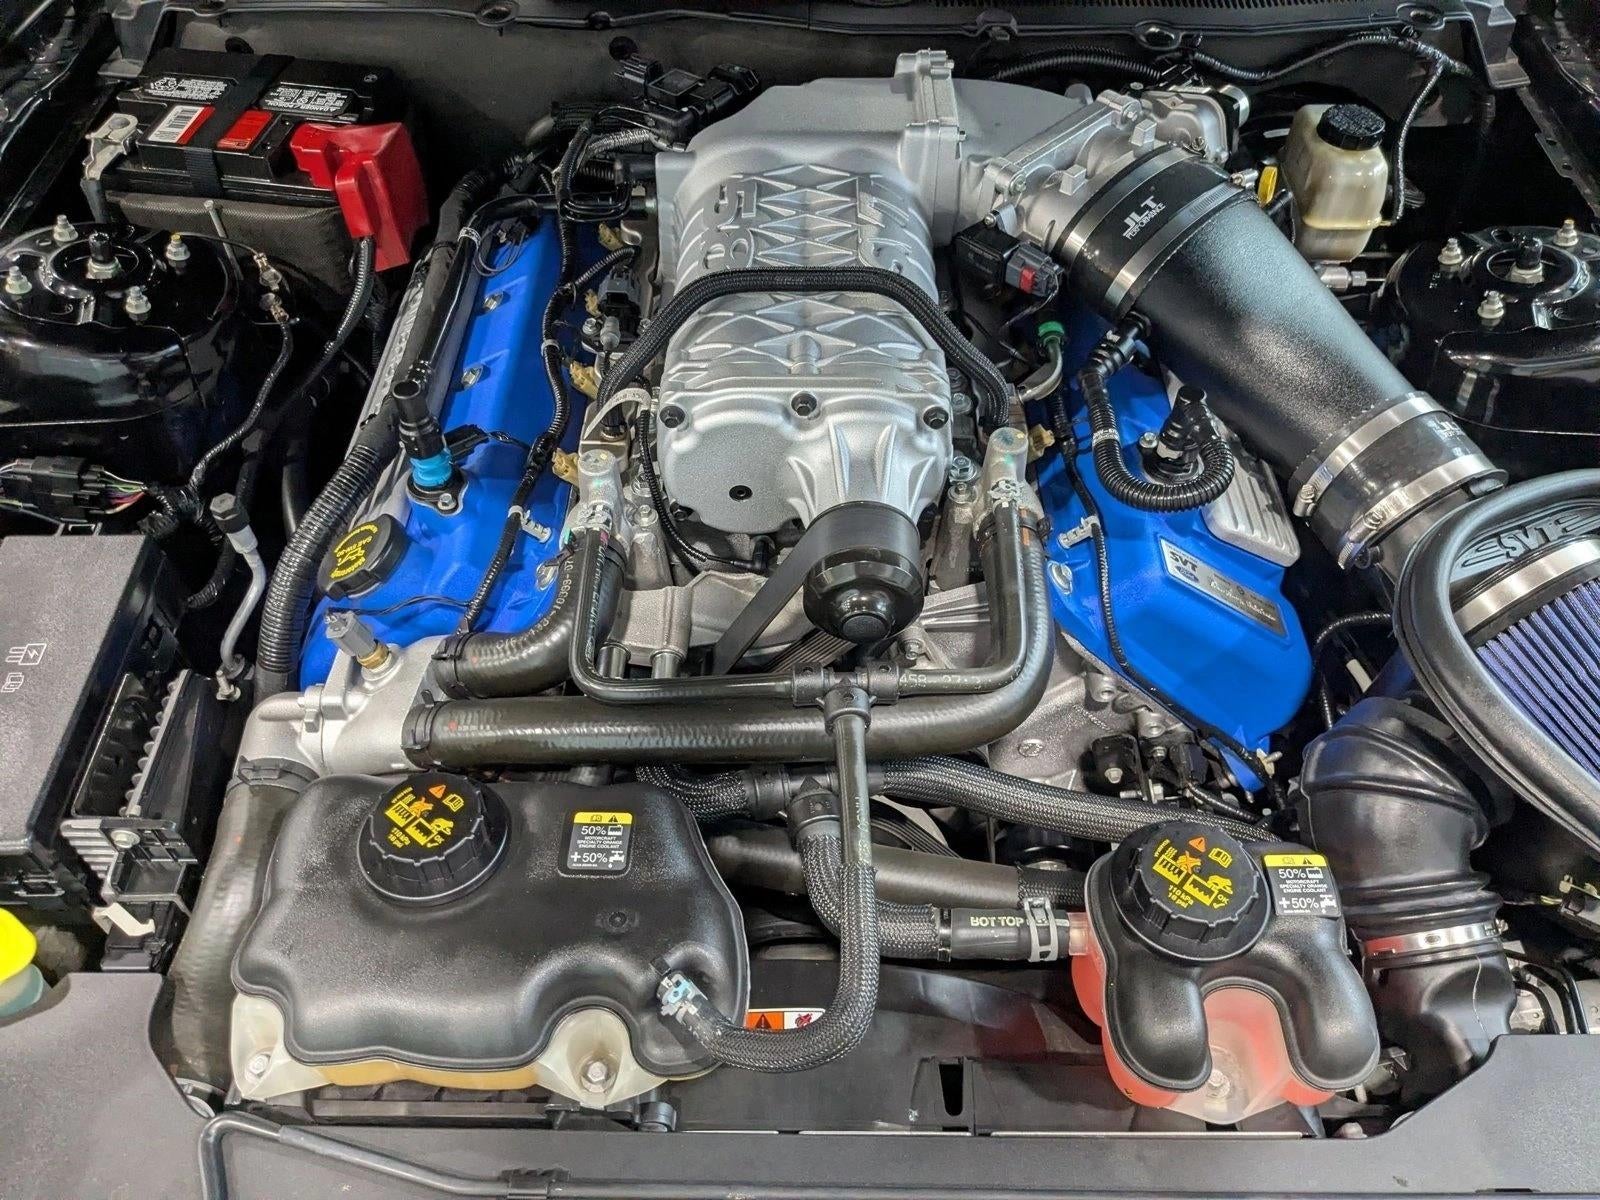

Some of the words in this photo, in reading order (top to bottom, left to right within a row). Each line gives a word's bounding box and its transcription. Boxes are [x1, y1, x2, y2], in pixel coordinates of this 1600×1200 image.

[1123, 195, 1157, 237] JLT
[1125, 202, 1166, 240] PERFORMANCE
[1496, 516, 1558, 559] SVT
[1169, 550, 1198, 572] SVT
[580, 825, 607, 836] 50%
[1278, 868, 1307, 879] 50%
[998, 916, 1025, 928] TOP
